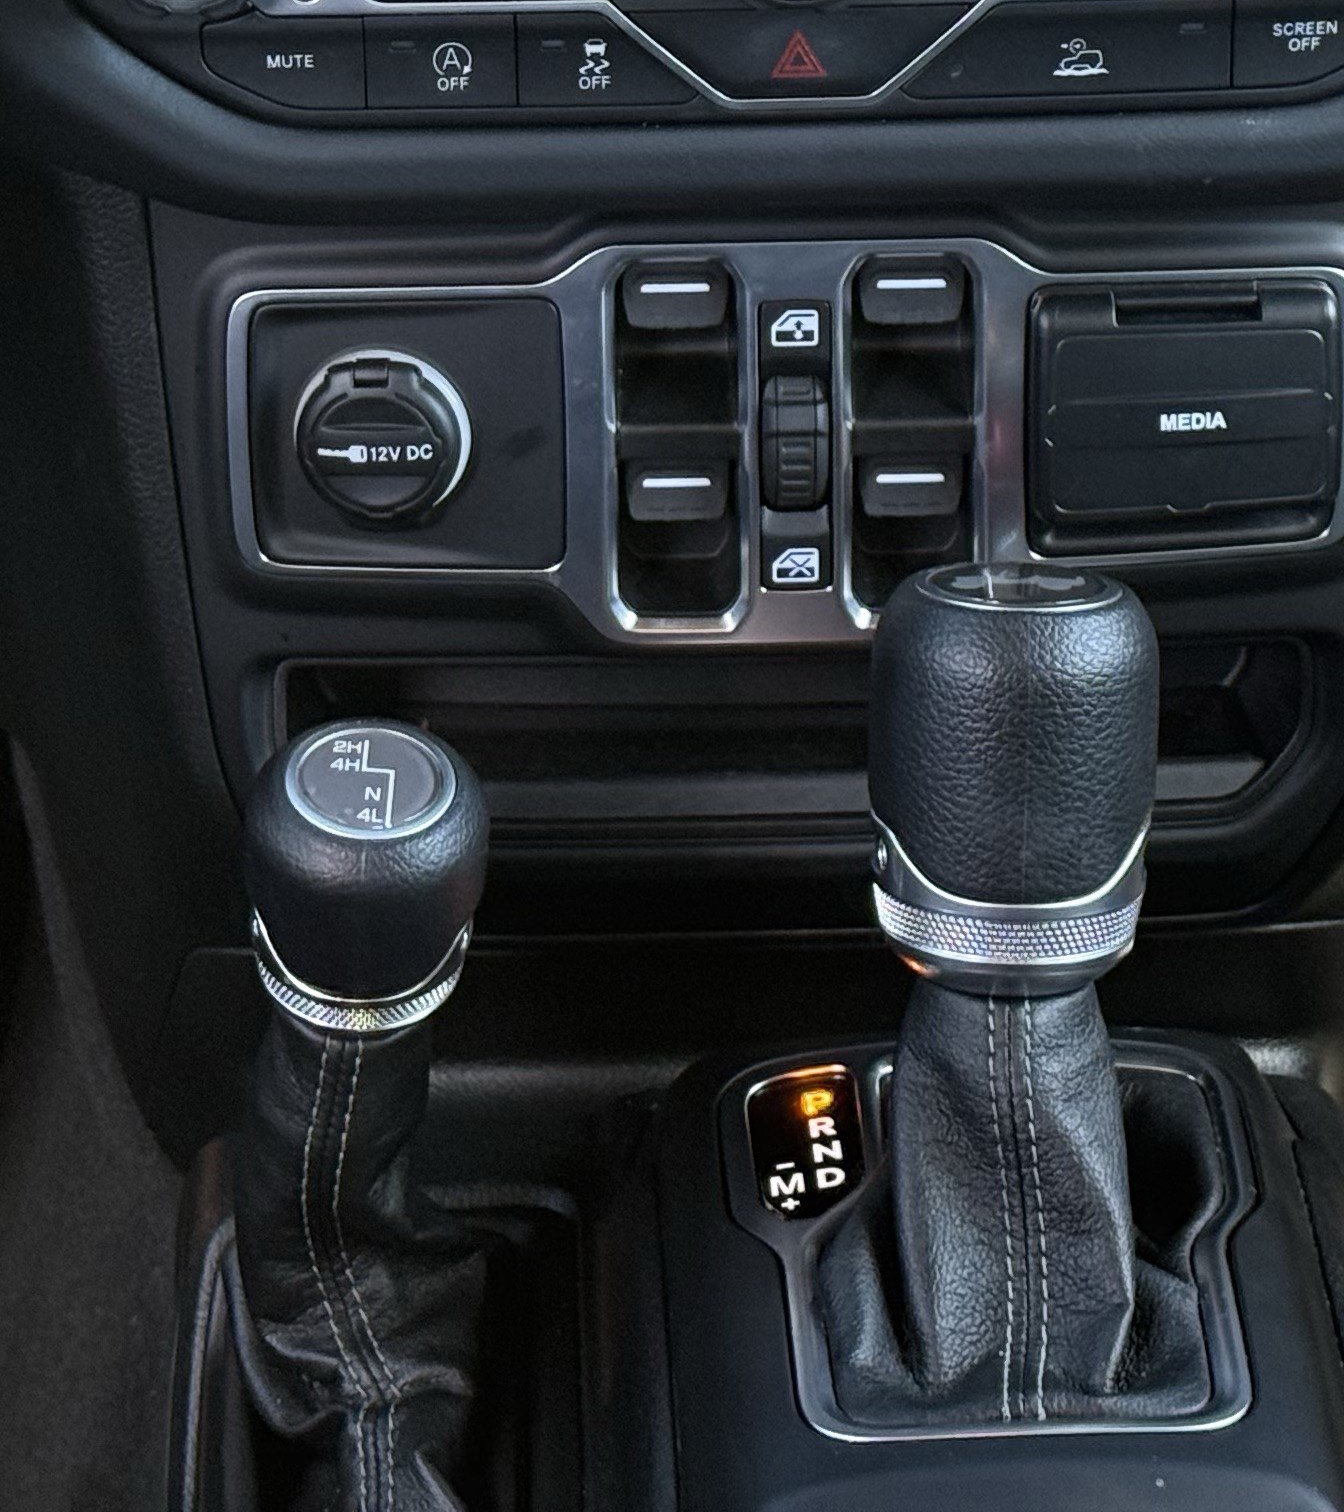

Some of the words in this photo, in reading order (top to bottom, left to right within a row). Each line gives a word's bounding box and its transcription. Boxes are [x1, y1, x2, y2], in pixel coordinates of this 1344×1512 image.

[1272, 20, 1338, 37] SCREEN
[1288, 37, 1320, 52] OFF
[266, 54, 315, 69] MUTE
[437, 76, 471, 92] OFF
[578, 75, 612, 91] OFF
[1159, 411, 1228, 432] MEDIA
[369, 445, 402, 463] 12V
[406, 443, 434, 461] DC
[332, 740, 362, 754] 2H
[329, 758, 360, 772] 4H
[364, 786, 381, 802] N
[356, 808, 383, 824] 4L
[800, 1089, 834, 1116] P
[808, 1116, 837, 1139] R
[812, 1139, 843, 1164] N
[769, 1172, 806, 1198] M
[815, 1166, 846, 1189] D
